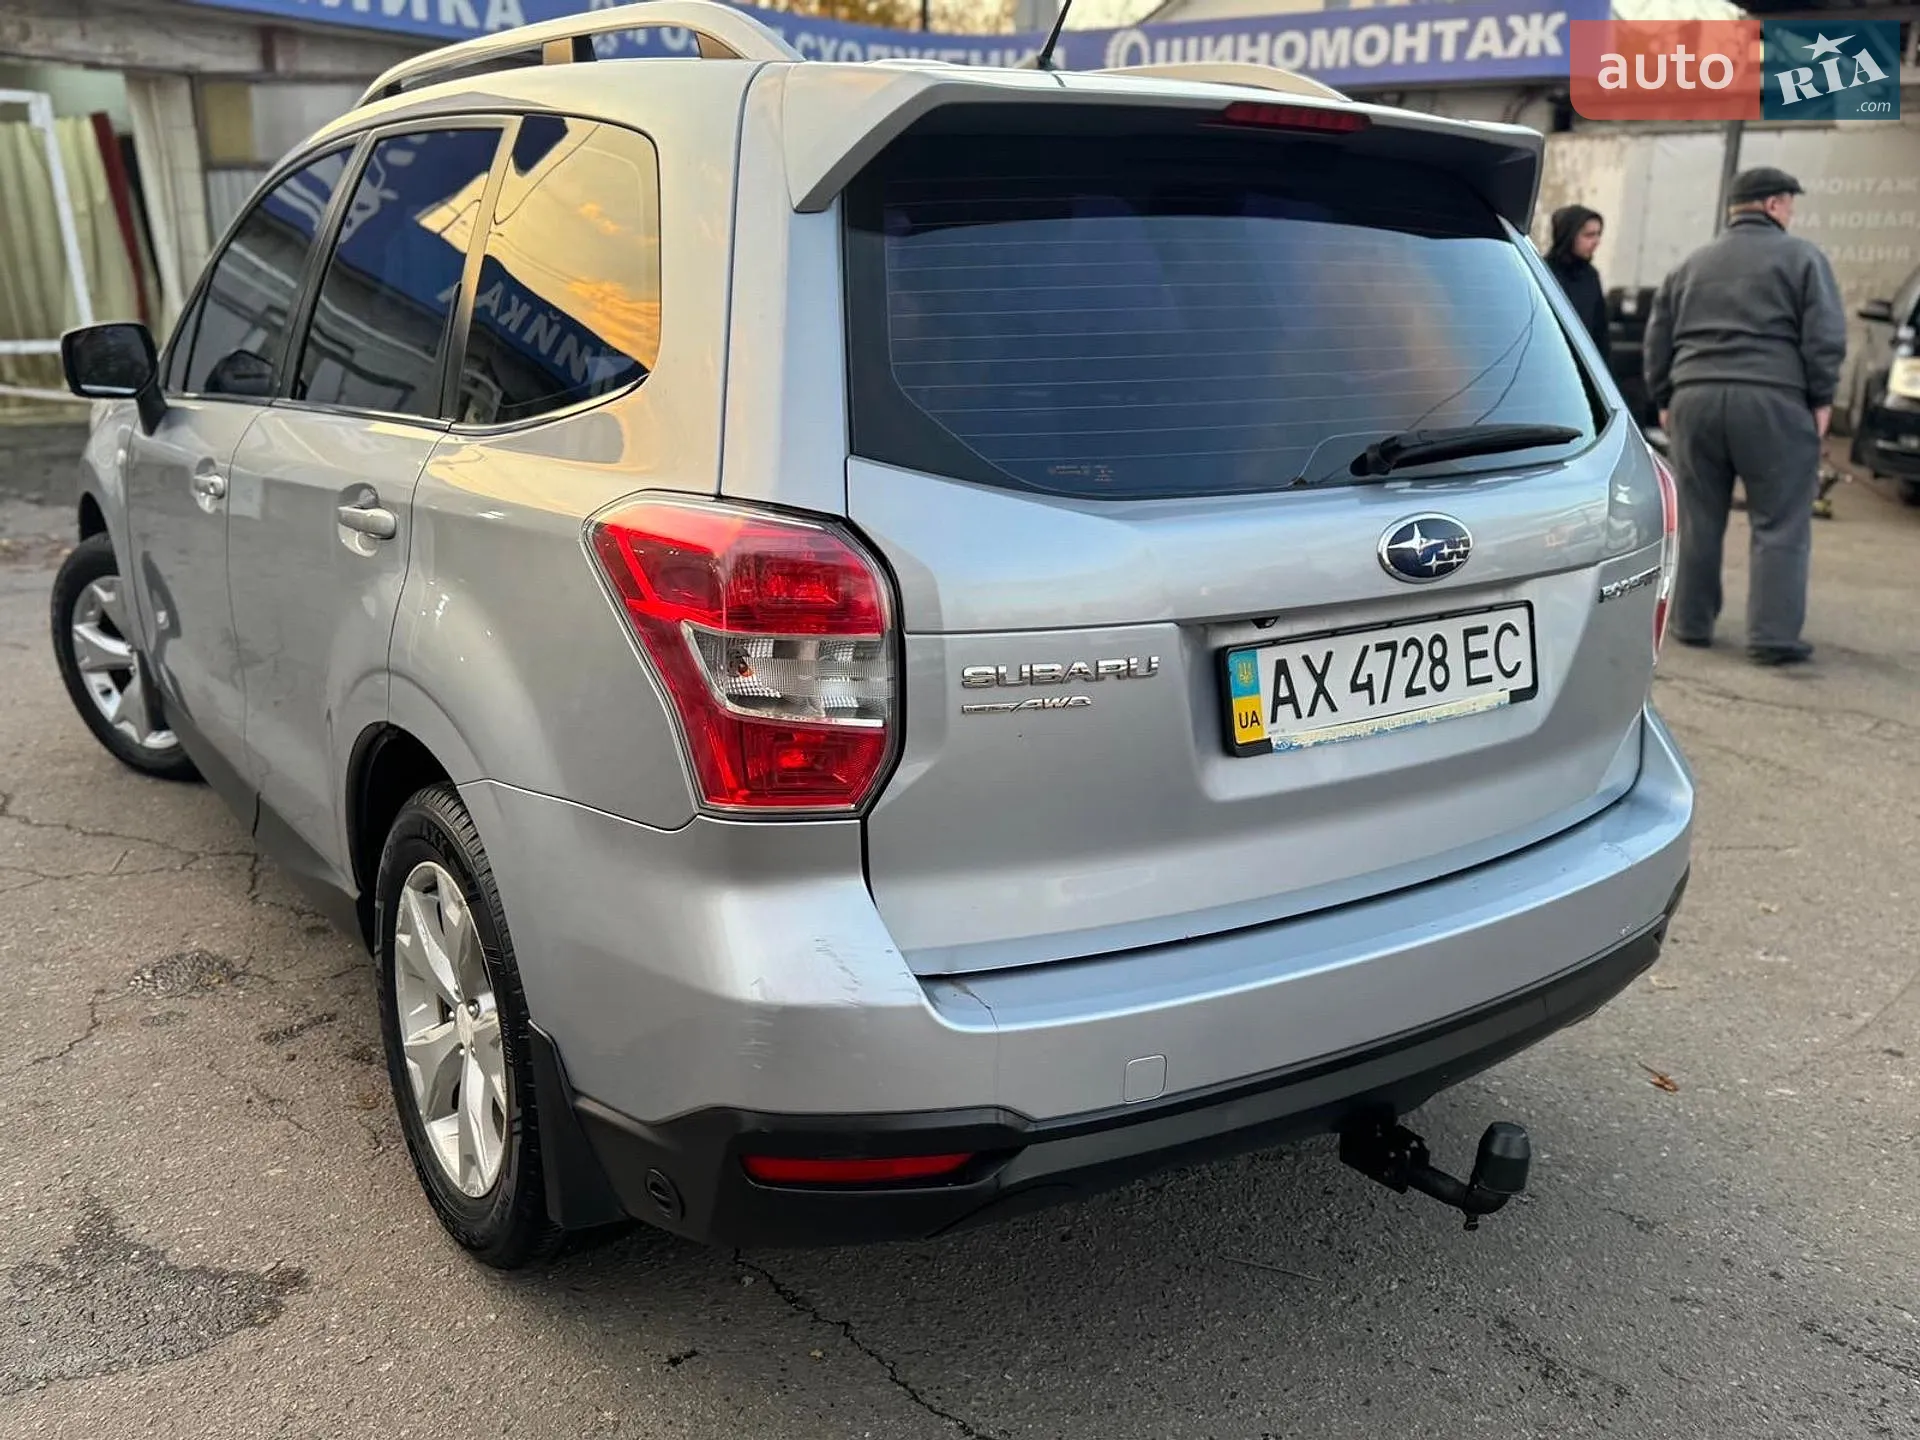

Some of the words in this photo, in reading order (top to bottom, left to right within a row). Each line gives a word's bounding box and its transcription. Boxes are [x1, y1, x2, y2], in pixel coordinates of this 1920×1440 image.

[1154, 12, 1567, 69] ШИНОМОНТАЖ
[961, 655, 1160, 689] SUBARU
[1270, 650, 1338, 724] AX
[1350, 633, 1450, 706] 4728
[1462, 621, 1521, 687] EC
[1239, 710, 1261, 730] UA
